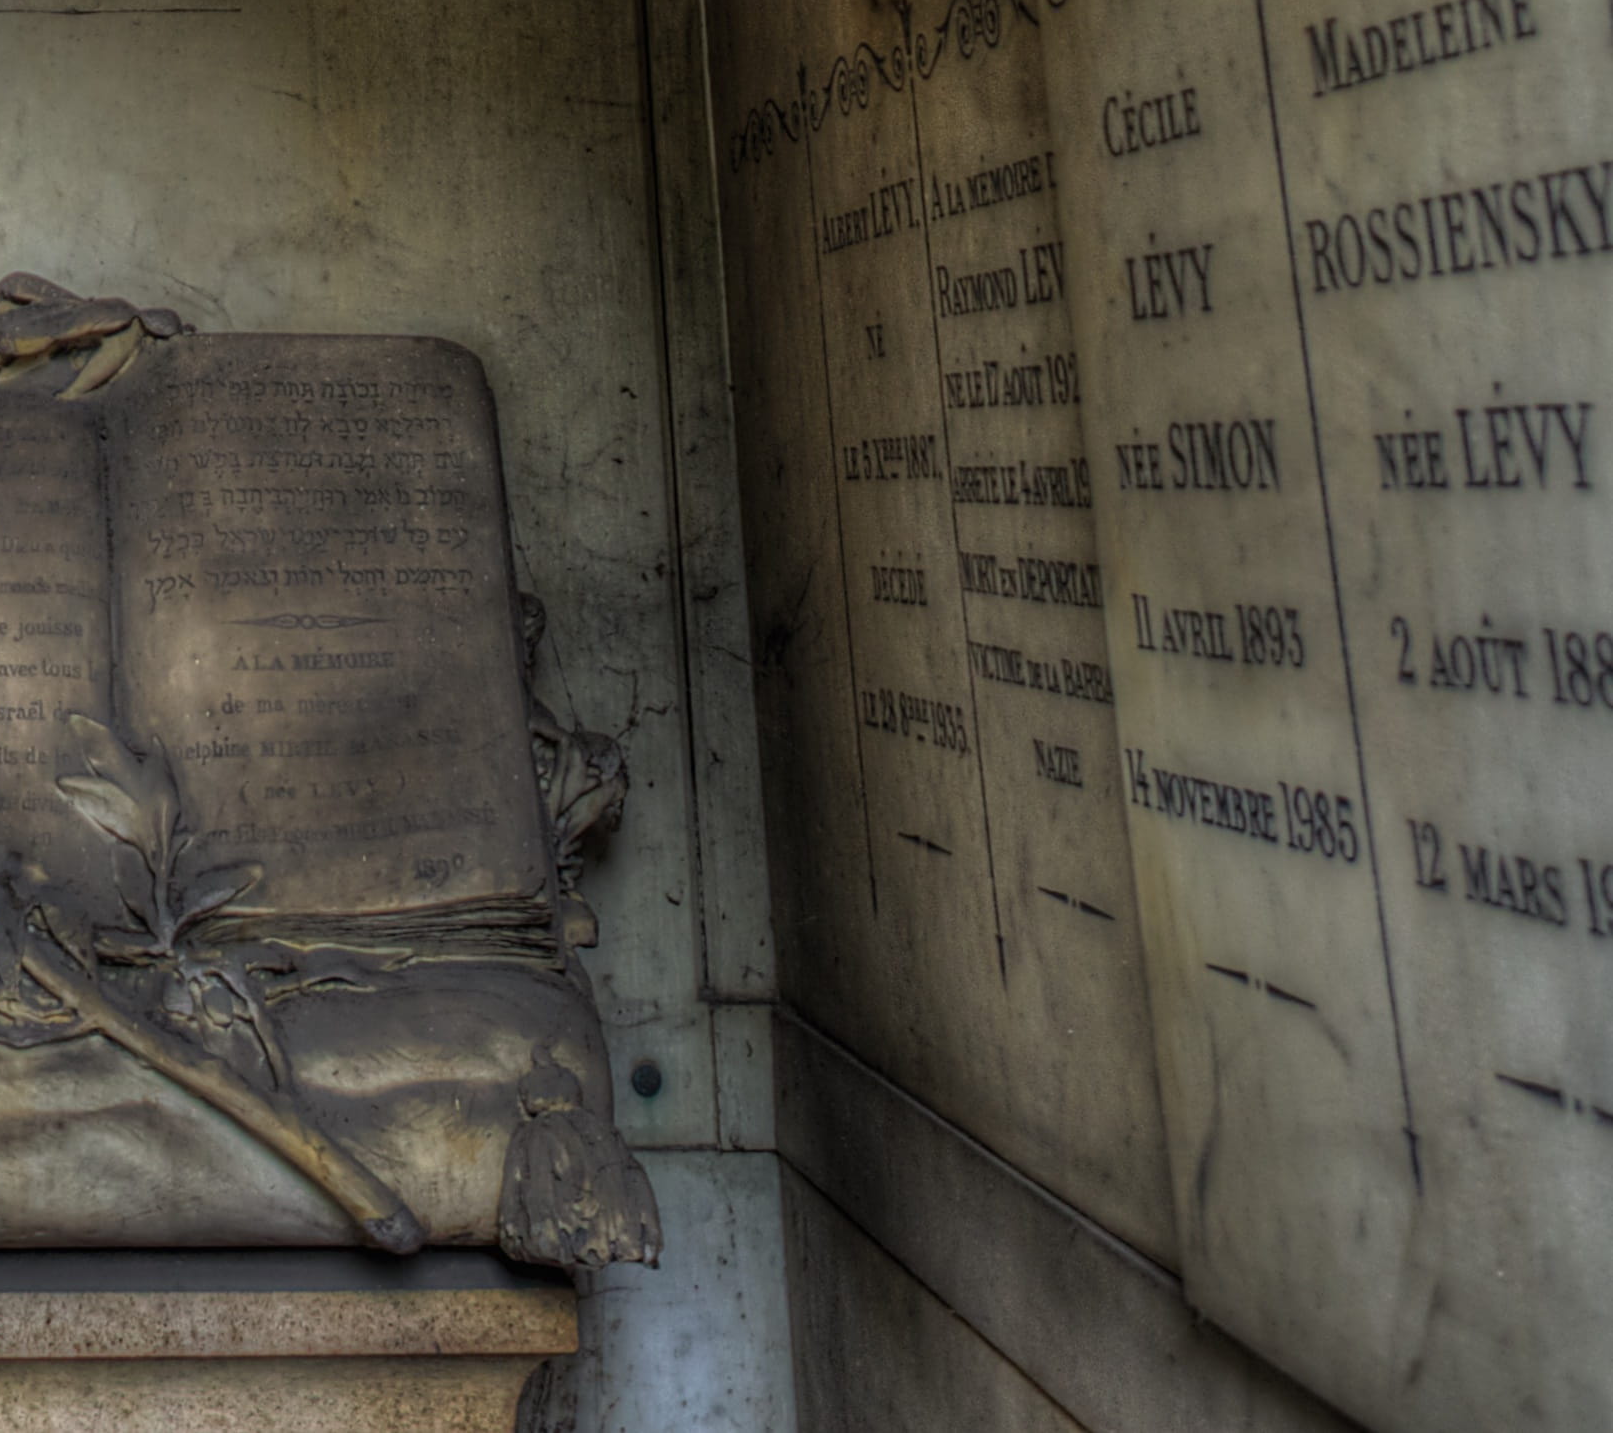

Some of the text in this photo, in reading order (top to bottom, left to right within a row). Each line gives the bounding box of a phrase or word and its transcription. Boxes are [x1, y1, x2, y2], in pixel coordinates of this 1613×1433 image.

[1102, 85, 1203, 158] CÉCILE
[946, 181, 968, 217] LA
[966, 152, 1044, 212] MÉMOIRE
[935, 224, 1065, 319] RAYMOND LÉV
[1124, 230, 1215, 322] LÉVY
[965, 370, 984, 409] LE
[842, 445, 862, 482] LE
[1114, 417, 1282, 494] NÉE SIMON
[1372, 378, 1597, 493] NÉE LÉVY
[870, 549, 928, 607] DÉCÉDÉ
[13, 616, 84, 642] jouisse
[1130, 591, 1307, 669] 11 AVRIL 1893
[1388, 609, 1613, 710] 2 AOÛT 188
[40, 659, 82, 679] tous
[860, 690, 880, 729] LE
[1031, 737, 1084, 790] NAZIE
[1124, 747, 1361, 864] 14 NOVEMBRE 1985
[1403, 816, 1571, 929] 12 MARS
